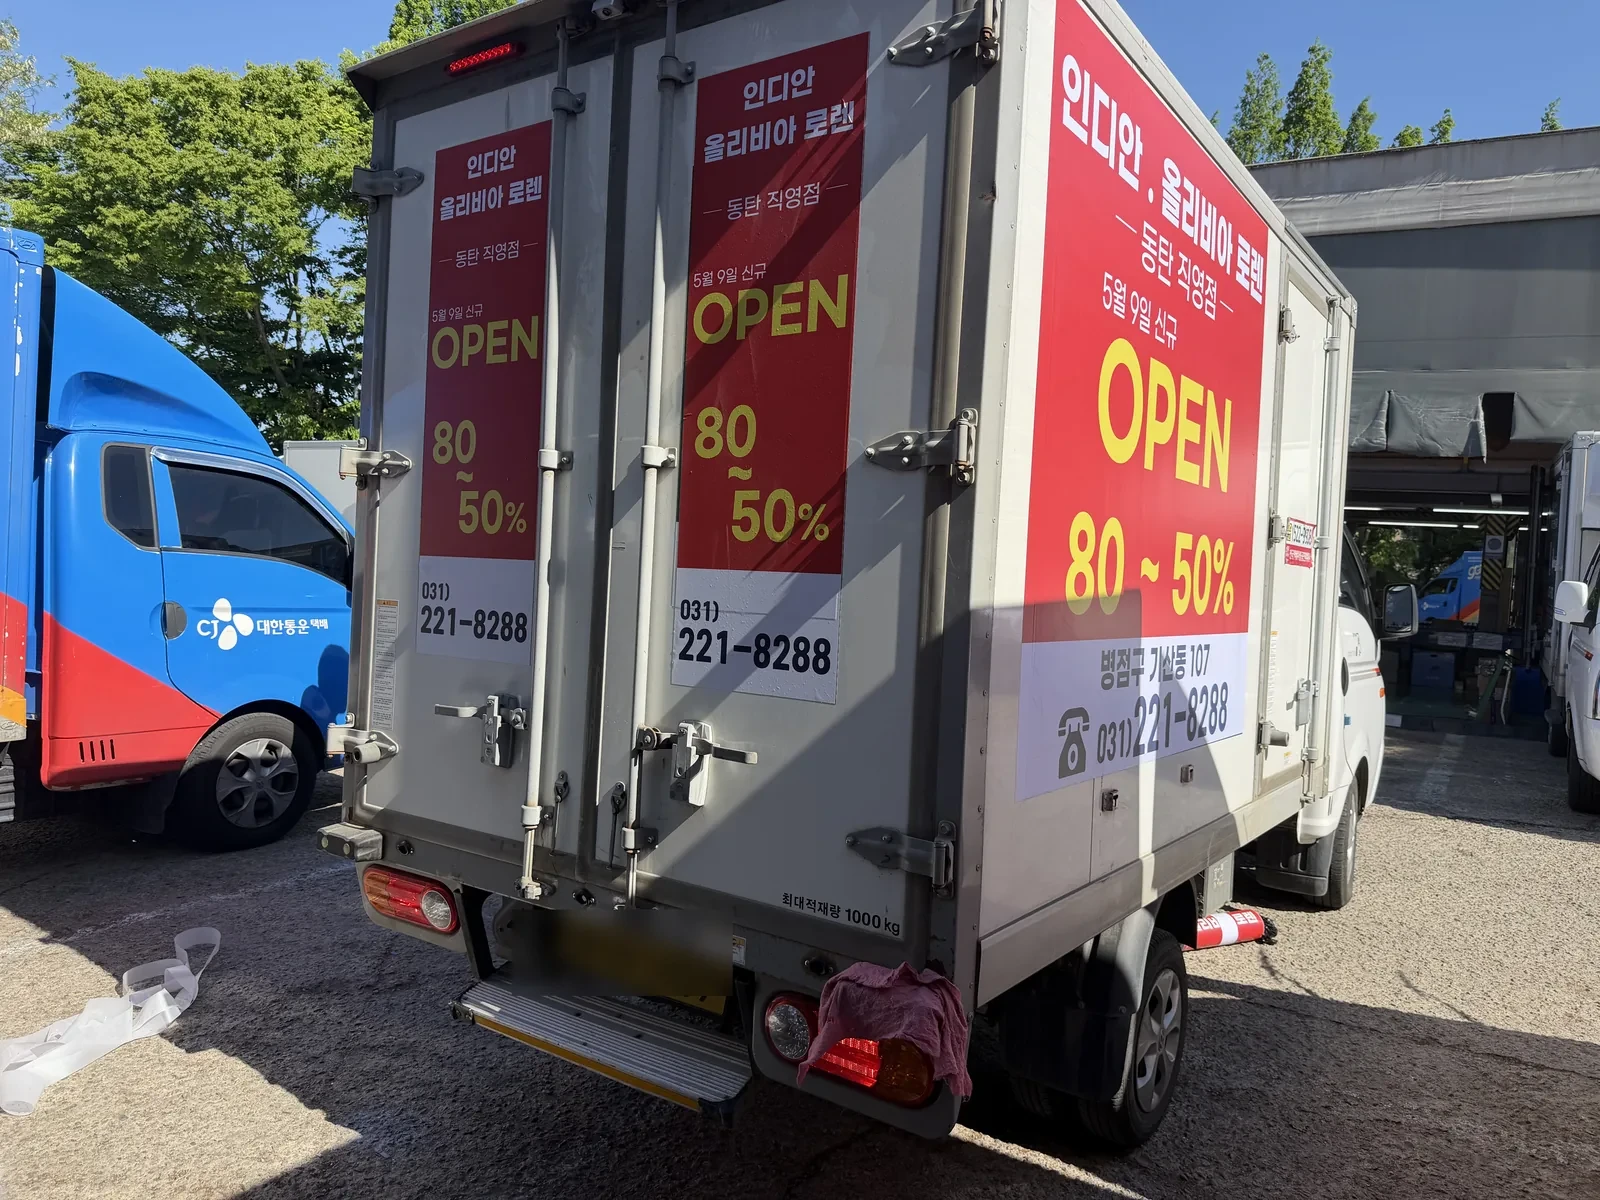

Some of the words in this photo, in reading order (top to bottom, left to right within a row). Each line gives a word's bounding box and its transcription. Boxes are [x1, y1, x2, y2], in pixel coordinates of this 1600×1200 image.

[744, 66, 815, 111] 인디안
[704, 116, 796, 163] 올리비아
[805, 100, 854, 139] 로렌
[467, 145, 516, 179] 인디안
[440, 185, 503, 221] 올리비아
[508, 176, 542, 206] 로렌
[727, 195, 759, 220] 동탄
[767, 182, 820, 211] 직영점
[1162, 157, 1233, 274] 올리비아
[1236, 233, 1264, 304] 로렌
[456, 245, 479, 268] 동탄
[483, 241, 519, 264] 직영점
[693, 271, 714, 288] 5월
[718, 267, 737, 284] 9일
[741, 263, 767, 280] 신규
[1141, 220, 1174, 287] 동탄
[1178, 252, 1217, 321] 직영점
[432, 308, 446, 323] 5월
[448, 306, 463, 321] 9일
[465, 304, 483, 319] 신규
[693, 275, 848, 345] OPEN
[1102, 271, 1126, 319] 5월
[1130, 290, 1151, 334] 9일
[1155, 307, 1178, 350] 신규
[432, 316, 539, 369] OPEN
[695, 405, 756, 459] 80
[1098, 338, 1232, 492] OPEN
[433, 420, 476, 464] 80
[458, 490, 526, 534] 50%
[732, 489, 830, 542] 50%
[1066, 511, 1124, 615] 80
[1172, 532, 1234, 615] 50%
[422, 582, 450, 602] 031)
[680, 599, 719, 622] 031)
[197, 620, 219, 639] CJ
[420, 605, 528, 643] 221-8288
[679, 628, 831, 675] 221-8288
[1101, 648, 1144, 690] 병점구
[1190, 644, 1210, 677] 107
[782, 892, 840, 919] 최대적재량
[845, 908, 881, 928] 1000
